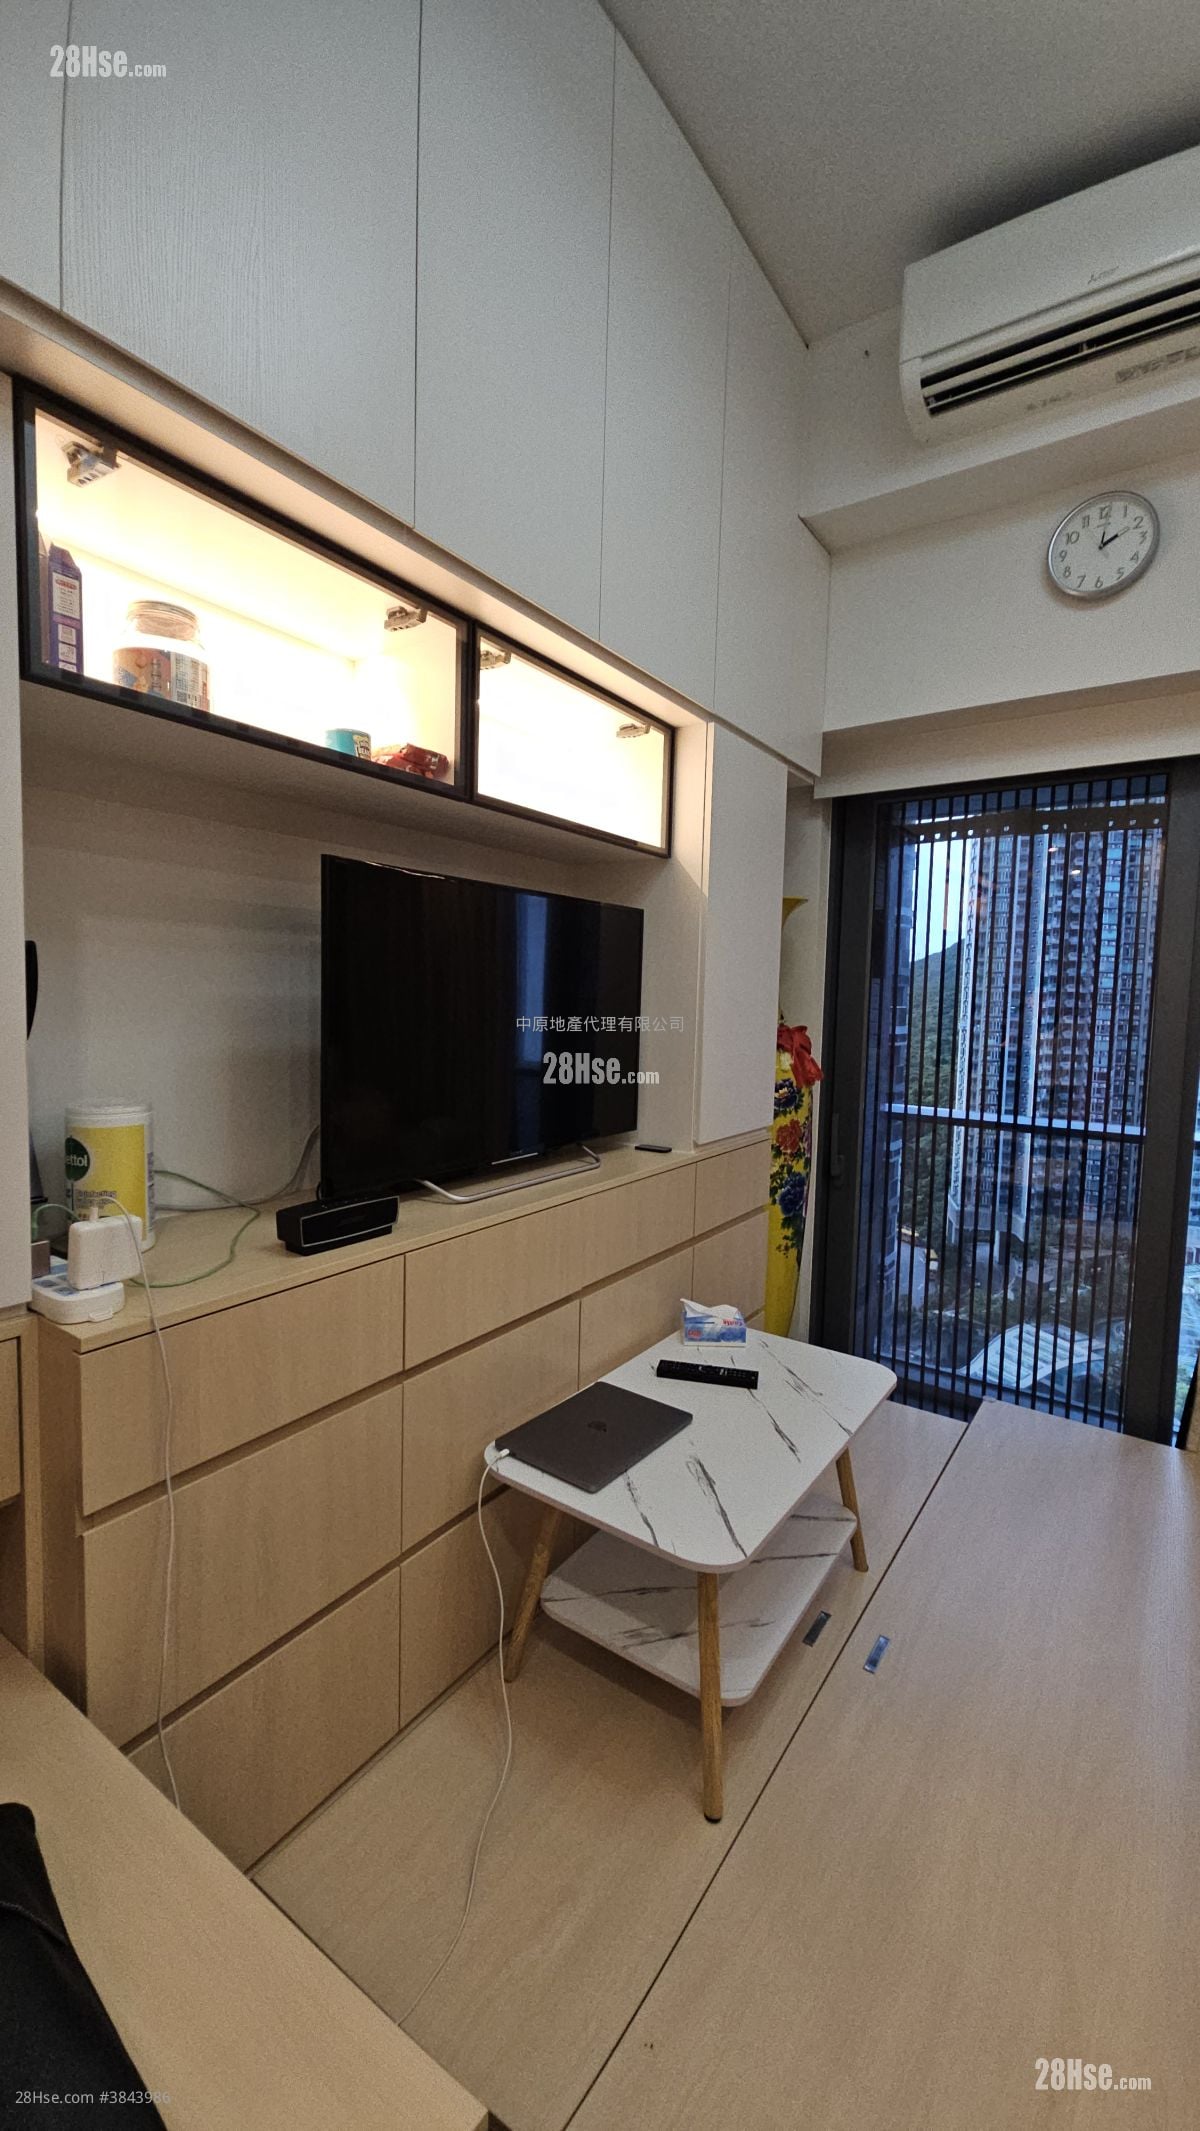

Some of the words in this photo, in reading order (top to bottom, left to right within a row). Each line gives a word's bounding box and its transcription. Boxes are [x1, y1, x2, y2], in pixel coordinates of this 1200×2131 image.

[1134, 516, 1144, 529] 2
[1066, 531, 1080, 545] 10
[1139, 530, 1148, 545] 3
[1059, 550, 1068, 562] 9
[1130, 551, 1139, 562] 4
[1063, 567, 1072, 578] 8
[1116, 567, 1125, 580] 5
[1077, 575, 1086, 588] 7
[1095, 576, 1104, 588] 6
